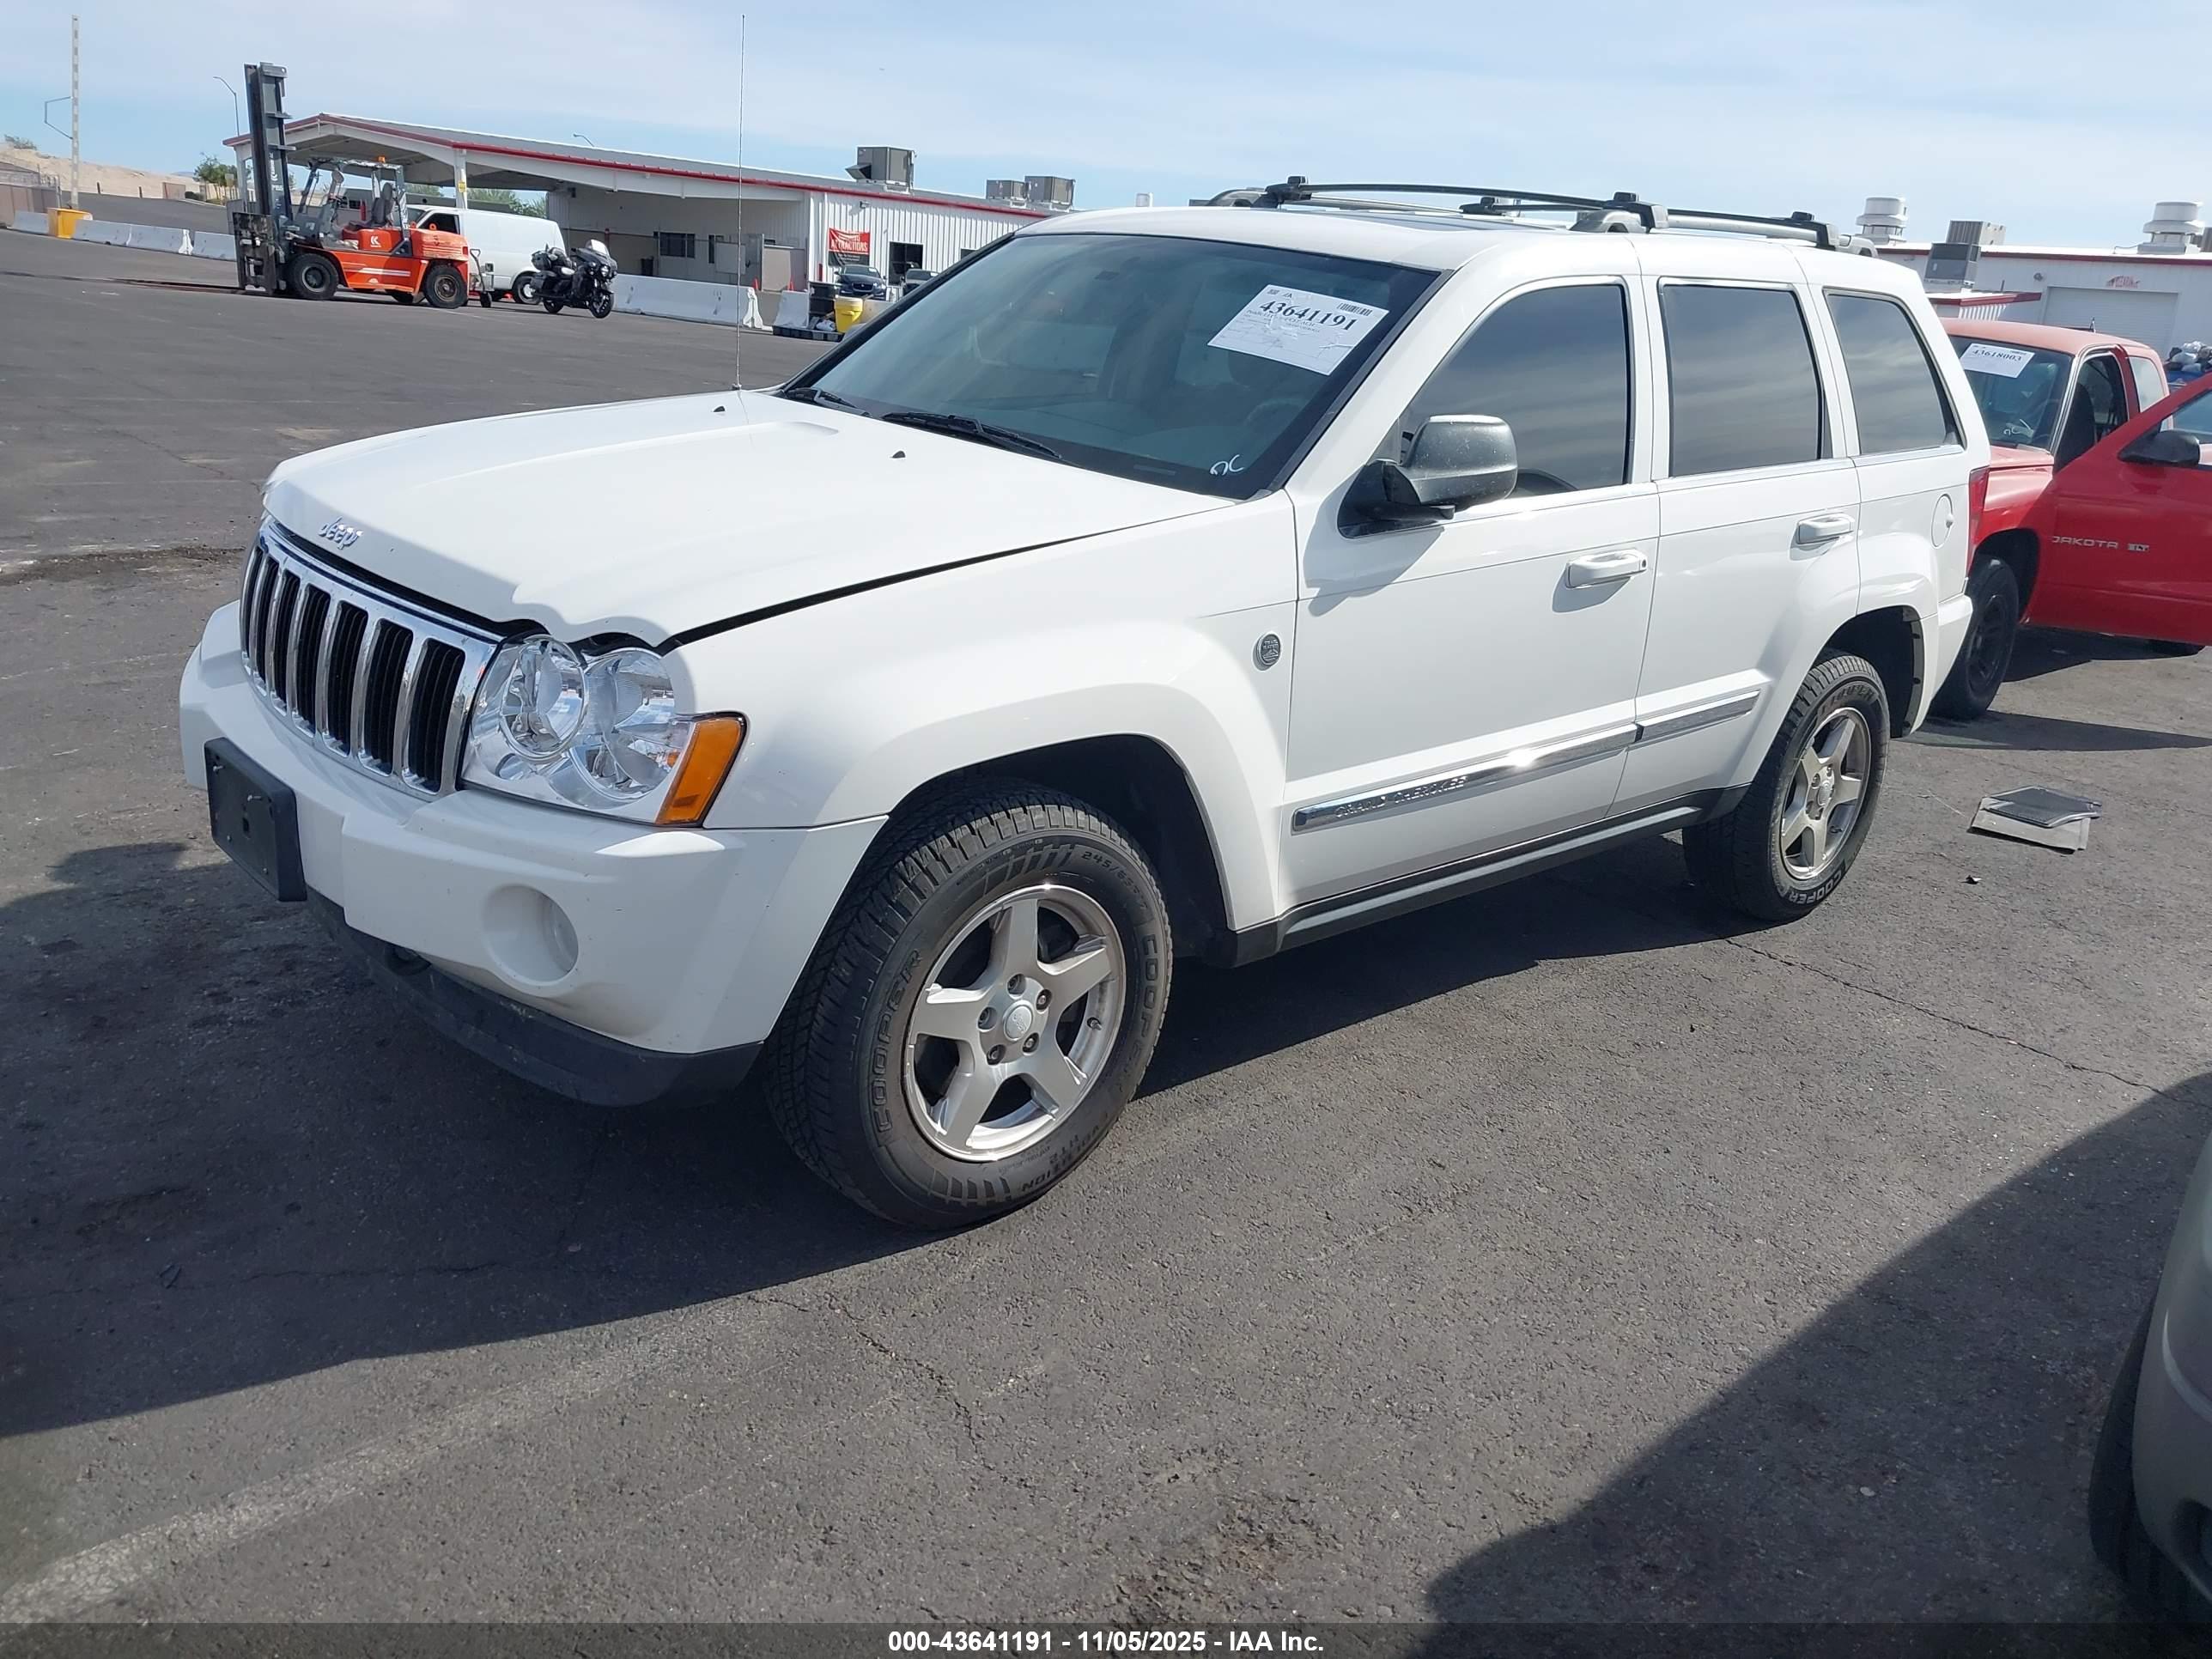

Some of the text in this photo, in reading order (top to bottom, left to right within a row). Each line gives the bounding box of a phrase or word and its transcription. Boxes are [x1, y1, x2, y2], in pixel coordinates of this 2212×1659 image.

[1260, 301, 1358, 331] 43641191
[318, 515, 363, 550] Jeep
[1393, 775, 1468, 805] CHEROKEE
[1788, 869, 1842, 905] COOPER
[1124, 933, 1158, 1075] COOPE
[871, 947, 923, 1133] COOPER
